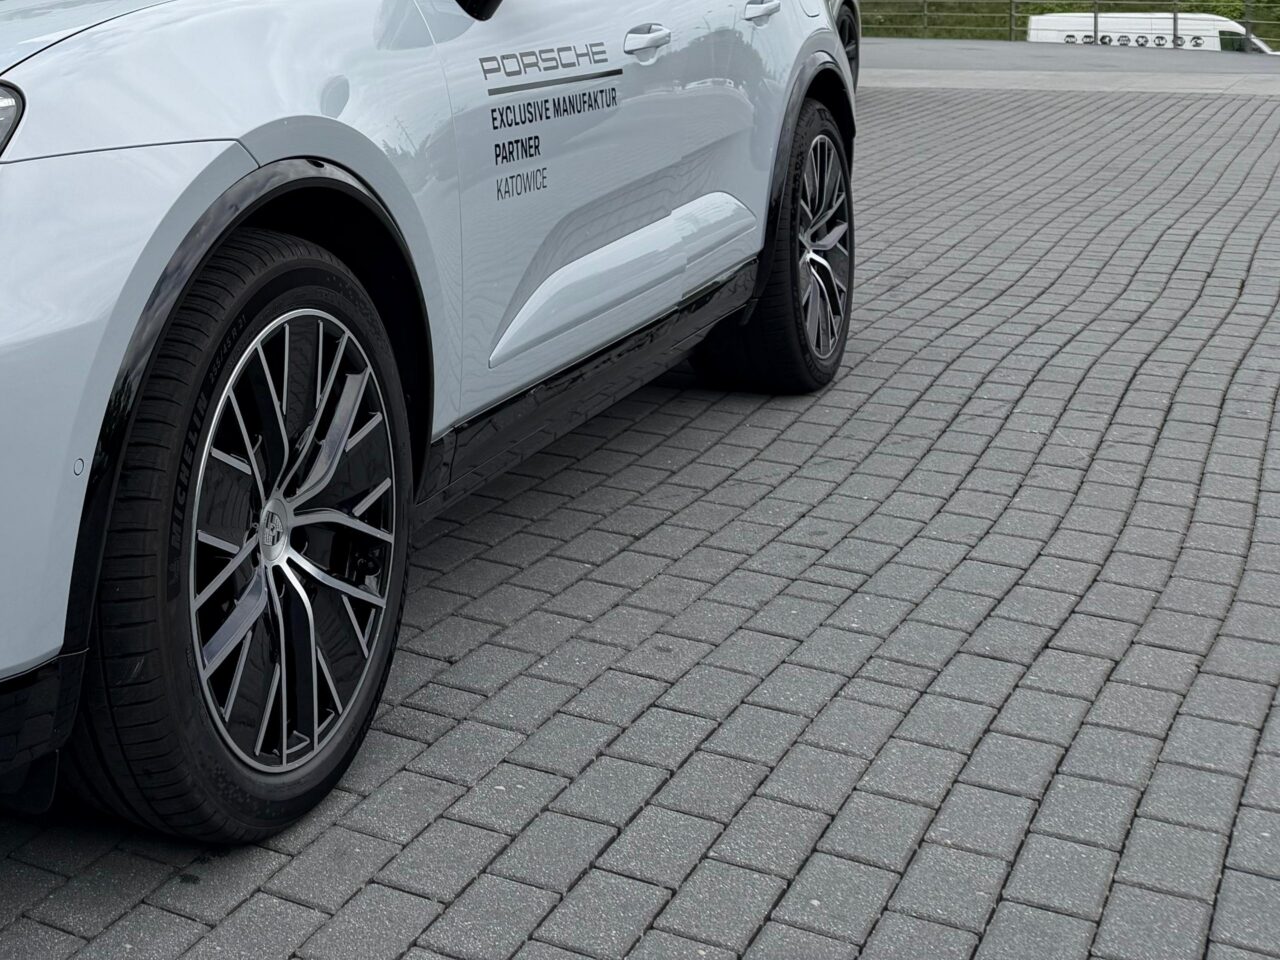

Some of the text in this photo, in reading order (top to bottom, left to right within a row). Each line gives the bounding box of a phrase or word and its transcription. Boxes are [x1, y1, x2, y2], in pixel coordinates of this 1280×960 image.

[479, 42, 608, 80] PORSCHE
[491, 87, 617, 130] EXCLUSIVE MANUFAKTUR
[494, 135, 541, 166] PARTNER
[496, 167, 548, 201] KATOWICE
[170, 392, 208, 551] MICHELIN
